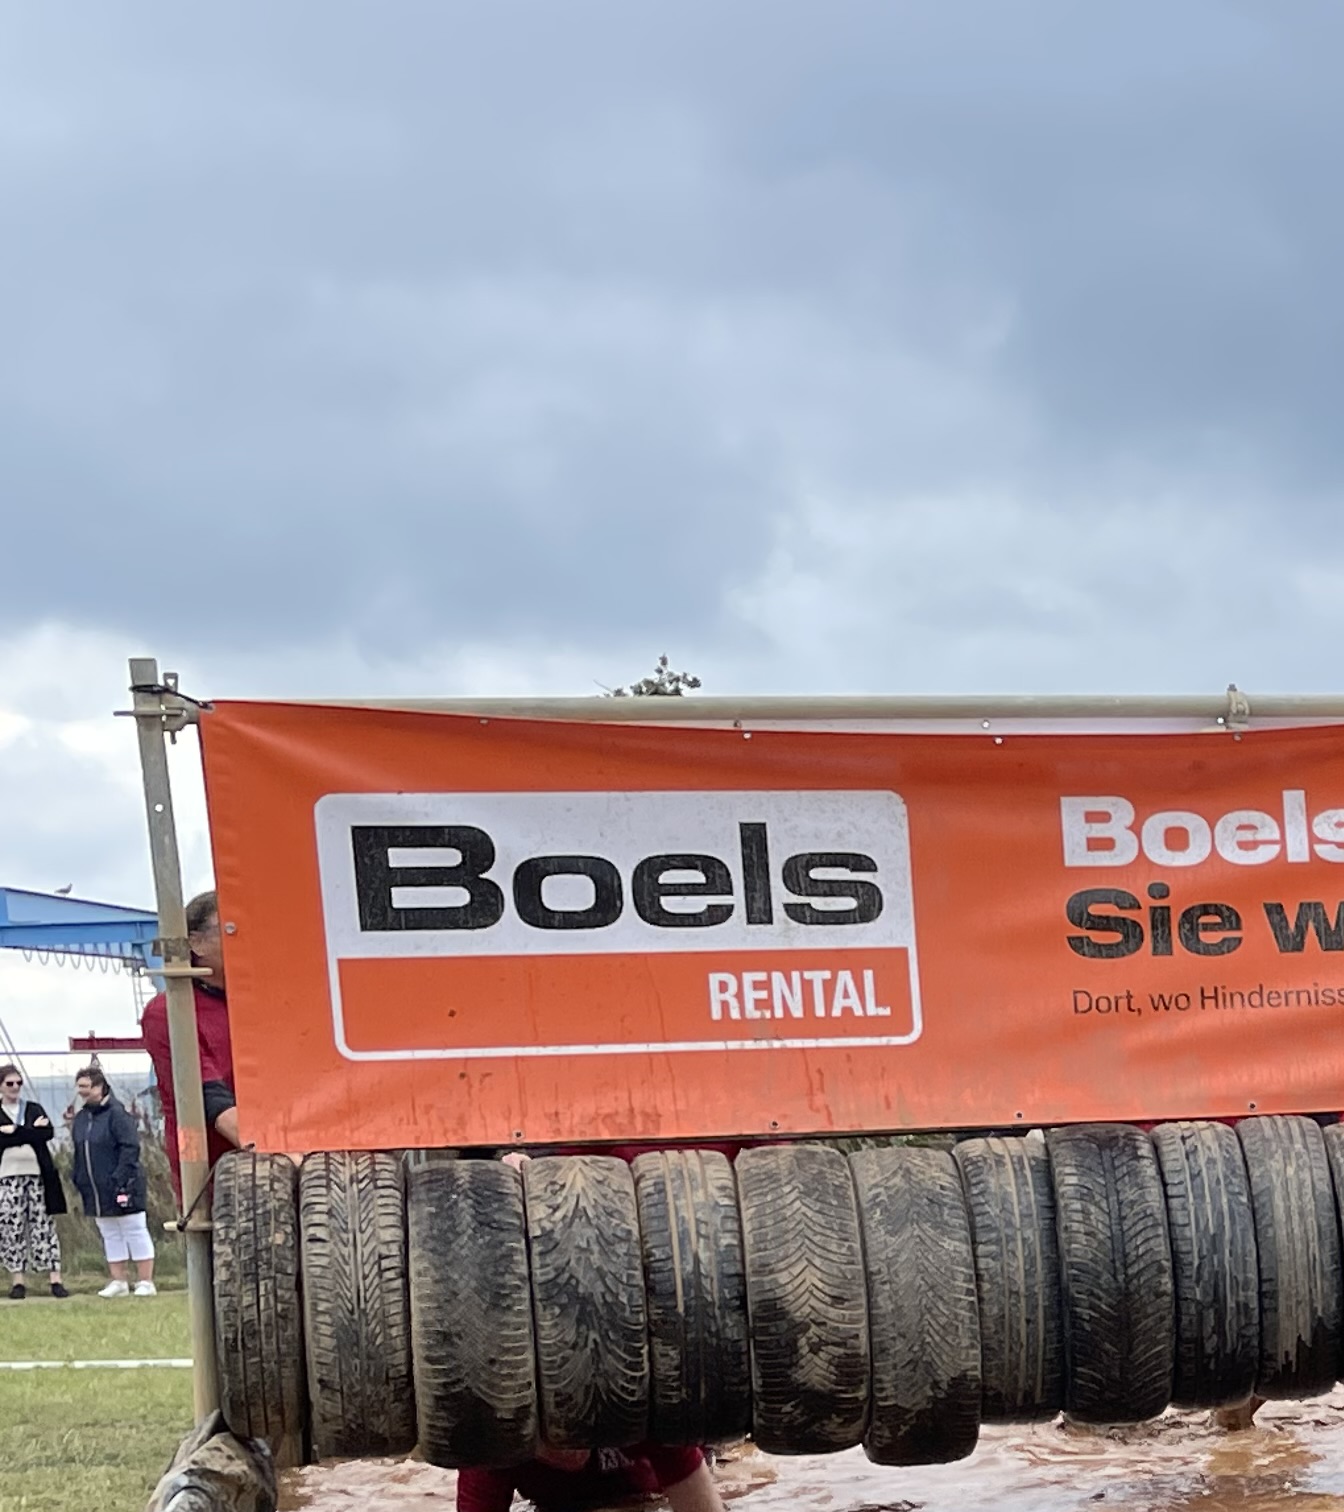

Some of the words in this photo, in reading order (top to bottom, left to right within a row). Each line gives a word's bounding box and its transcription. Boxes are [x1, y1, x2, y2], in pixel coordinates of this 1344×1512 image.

[350, 821, 886, 933] Boels
[1065, 882, 1243, 959] Sie
[708, 968, 891, 1022] RENTAL
[1072, 988, 1143, 1017] Dort,
[1149, 991, 1192, 1012] wo
